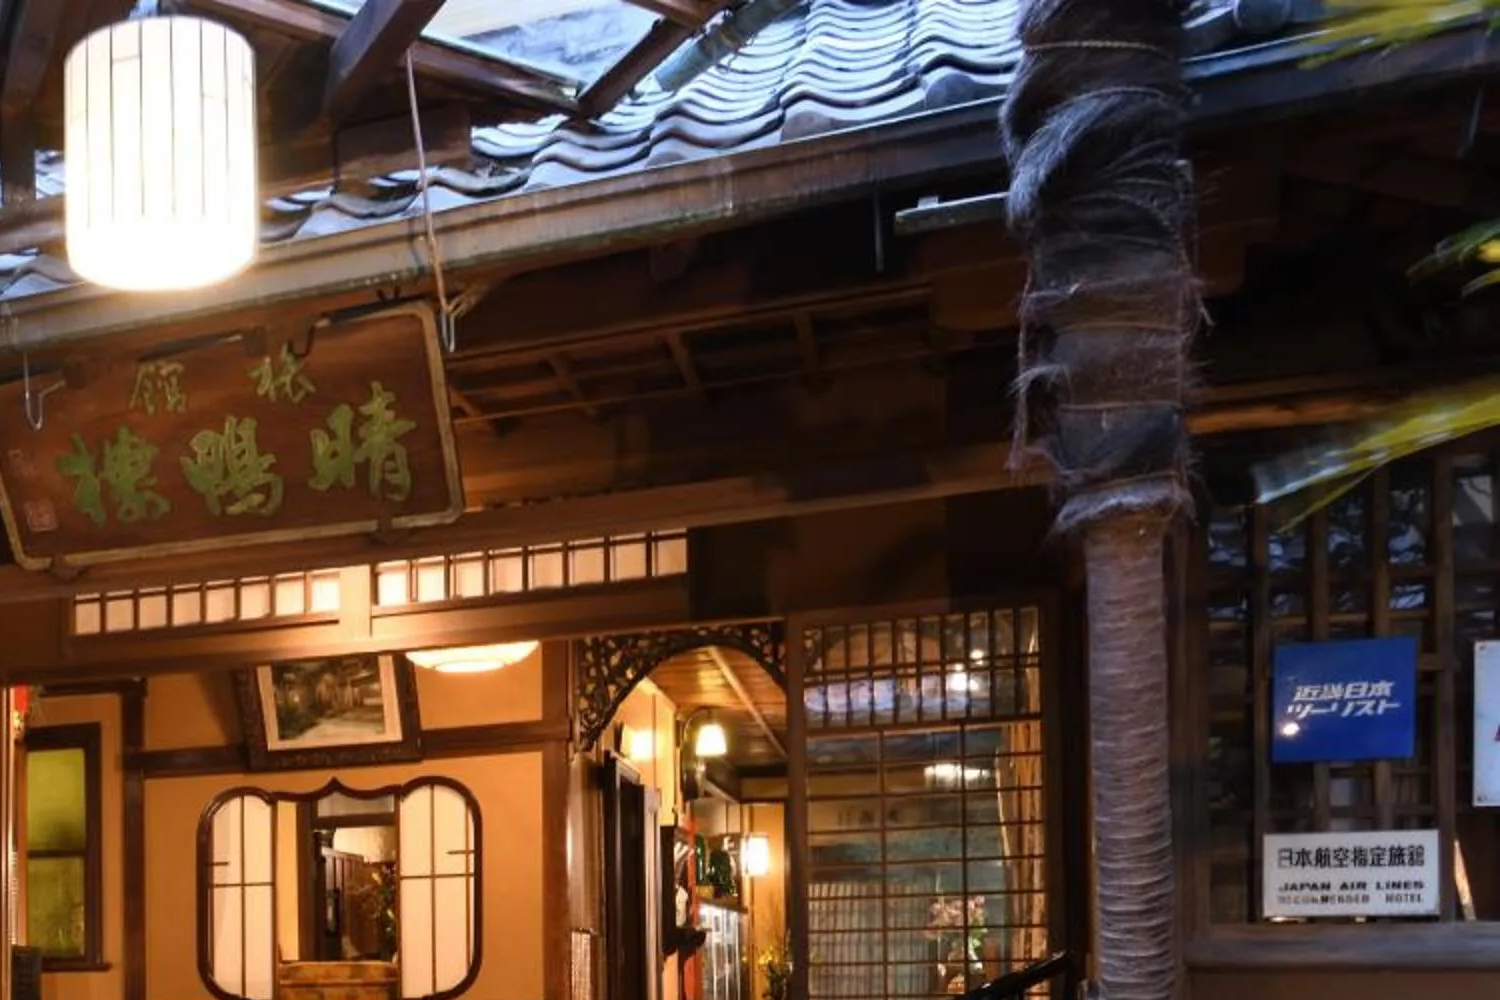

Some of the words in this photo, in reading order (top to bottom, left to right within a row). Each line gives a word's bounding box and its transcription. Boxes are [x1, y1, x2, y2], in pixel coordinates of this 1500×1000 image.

[1293, 680, 1396, 701] 近畿日本
[1287, 699, 1401, 721] ツーリスト
[1278, 881, 1331, 892] JAPAN
[1339, 880, 1367, 891] AIR
[1375, 879, 1424, 890] LINES
[1385, 893, 1422, 904] HOTEL
